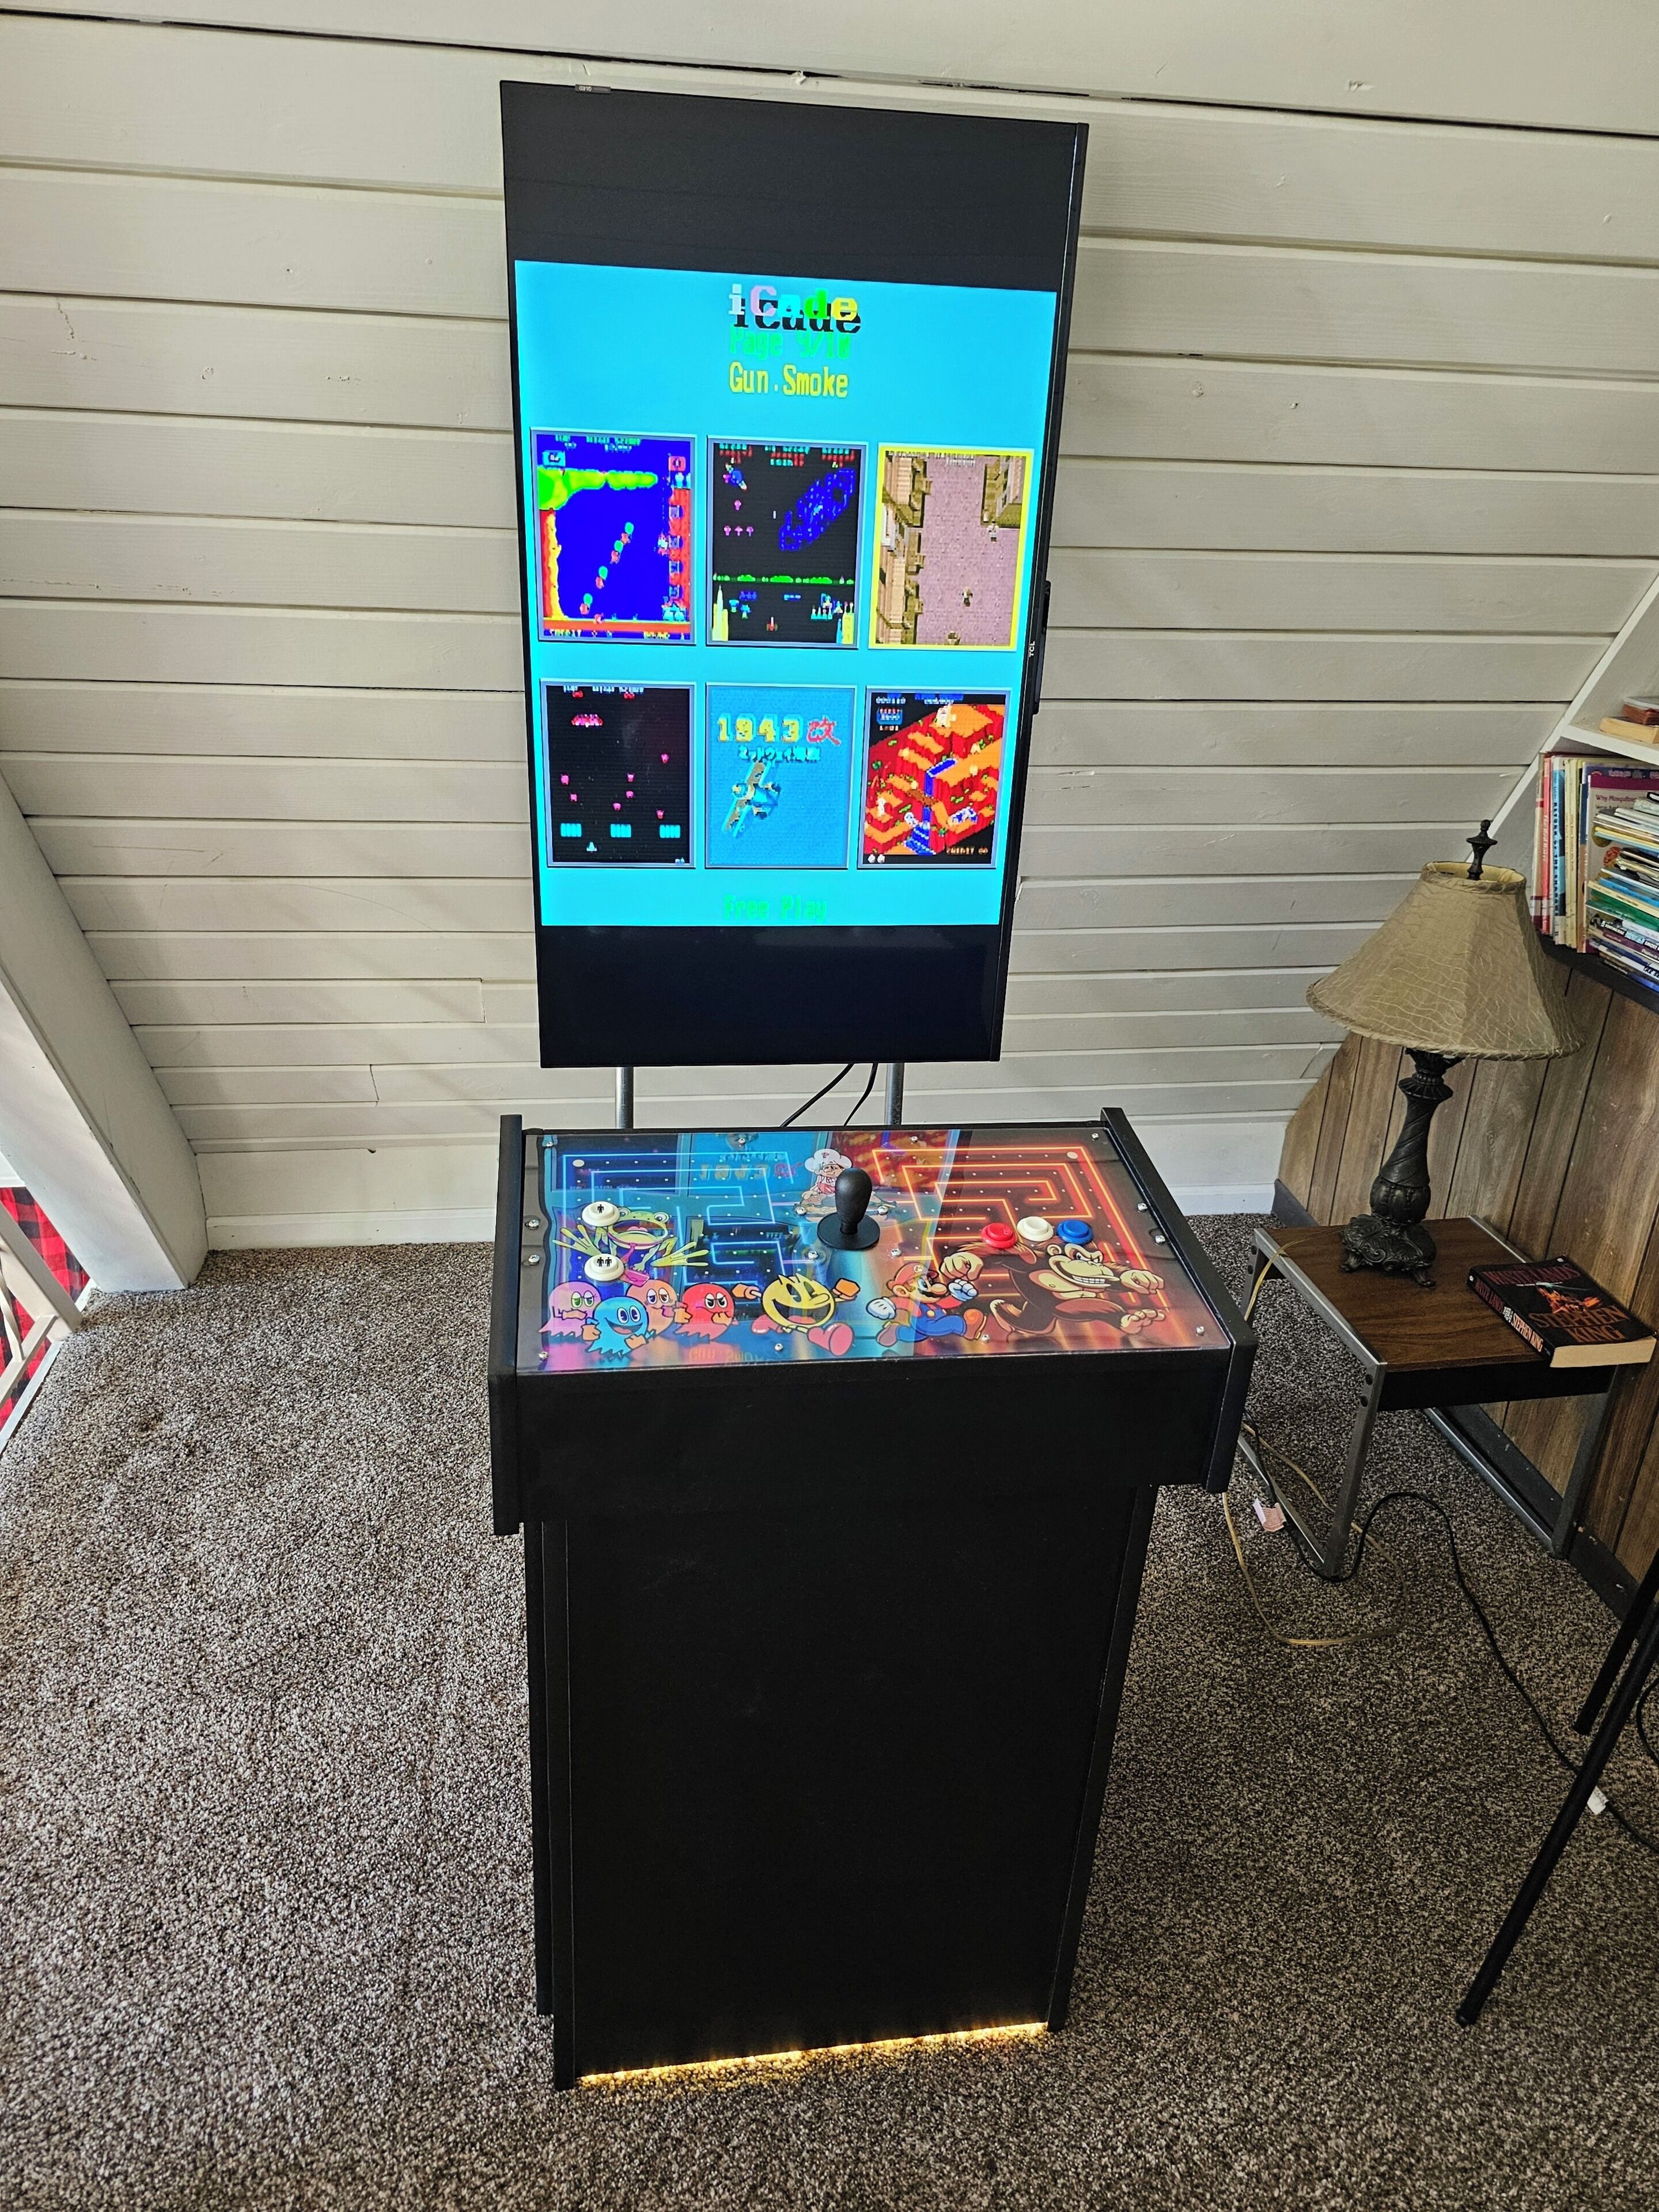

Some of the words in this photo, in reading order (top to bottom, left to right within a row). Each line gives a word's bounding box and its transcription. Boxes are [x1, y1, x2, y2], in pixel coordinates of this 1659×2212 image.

[729, 283, 858, 326] iCade
[781, 894, 828, 922] Play
[1528, 1305, 1630, 1328] STEPHEN
[1510, 1313, 1533, 1342] STEPHEN
[1530, 1331, 1544, 1353] KING
[1565, 1325, 1626, 1343] KING
